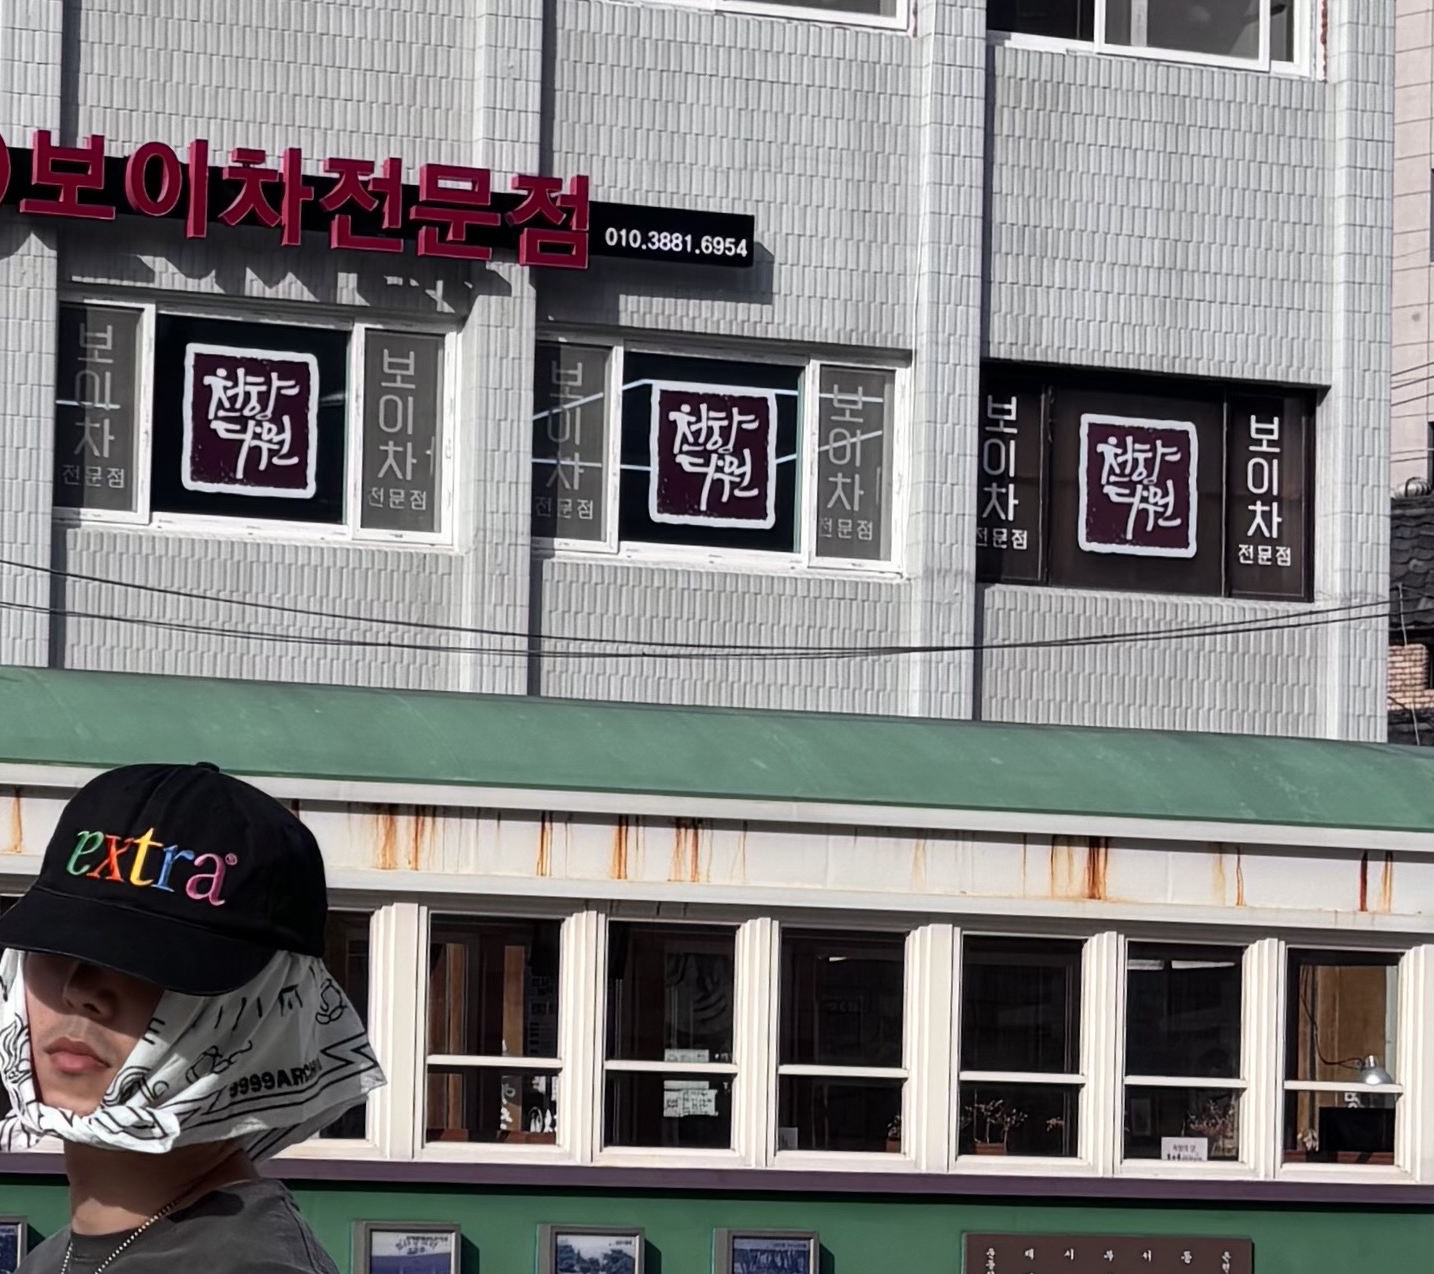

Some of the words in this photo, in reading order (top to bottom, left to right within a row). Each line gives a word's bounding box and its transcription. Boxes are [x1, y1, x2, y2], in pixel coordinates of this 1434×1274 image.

[20, 130, 590, 270] 보이차전문점
[605, 226, 748, 258] 010.3881.6954
[73, 322, 115, 458] 보이차
[378, 347, 416, 482] 보이차
[546, 359, 585, 491] 보이차
[62, 464, 125, 489] 전문점
[826, 383, 865, 512] 보이차
[981, 394, 1019, 522] 보이차
[1246, 414, 1283, 541] 보이차
[367, 485, 428, 512] 전문점
[534, 496, 594, 520] 전문점
[818, 517, 874, 542] 전문점
[976, 526, 1028, 551] 전문점
[1237, 543, 1293, 568] 전문점
[66, 826, 227, 907] extra
